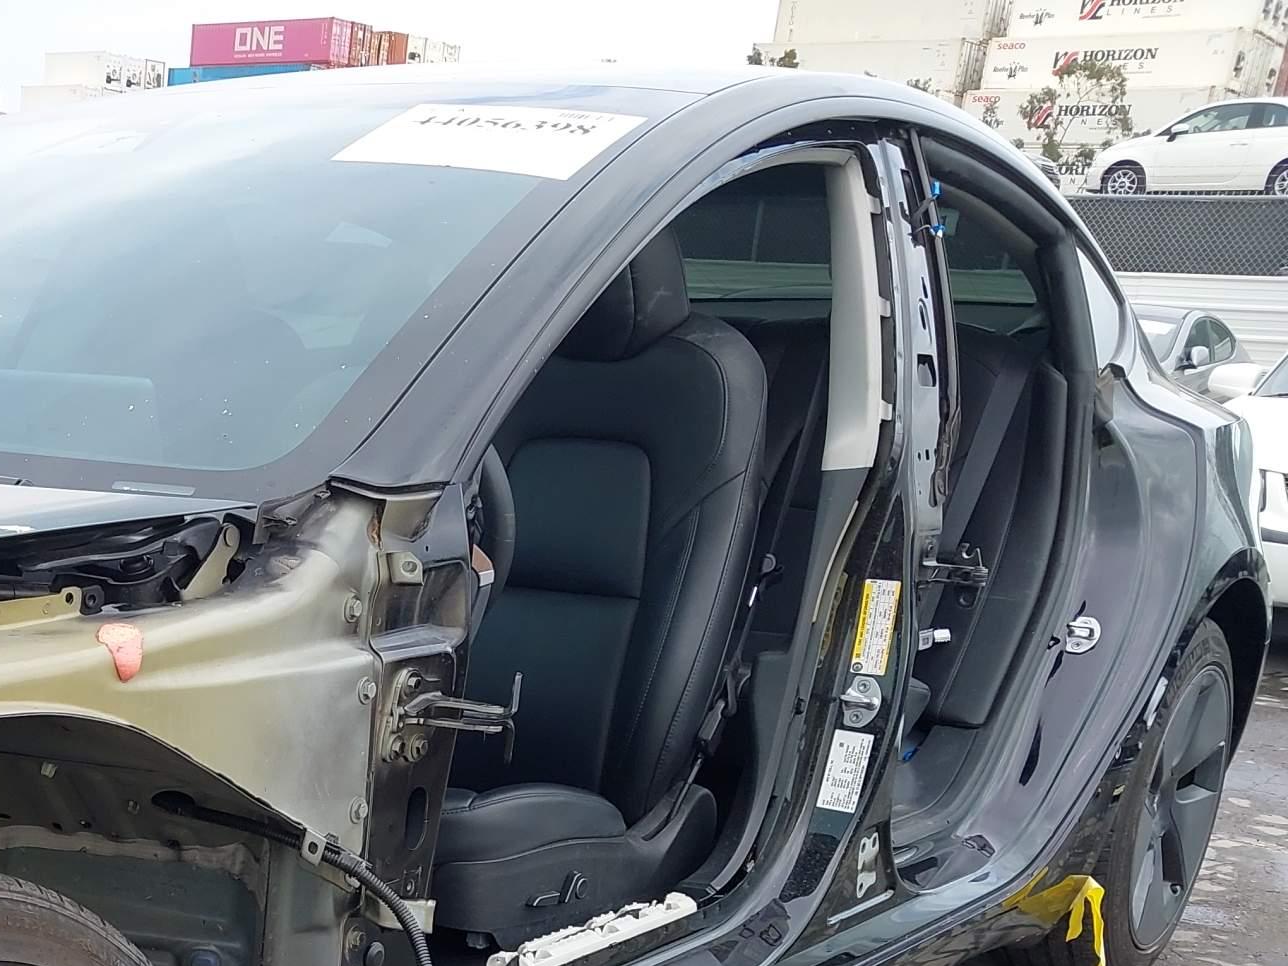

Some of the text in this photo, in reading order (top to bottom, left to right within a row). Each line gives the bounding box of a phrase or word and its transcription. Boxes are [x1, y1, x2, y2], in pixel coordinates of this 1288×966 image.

[234, 25, 285, 51] ONE
[997, 42, 1026, 50] seaco
[1080, 48, 1159, 63] HORIZON
[972, 95, 1001, 104] seaco
[1058, 103, 1132, 117] HORIZON
